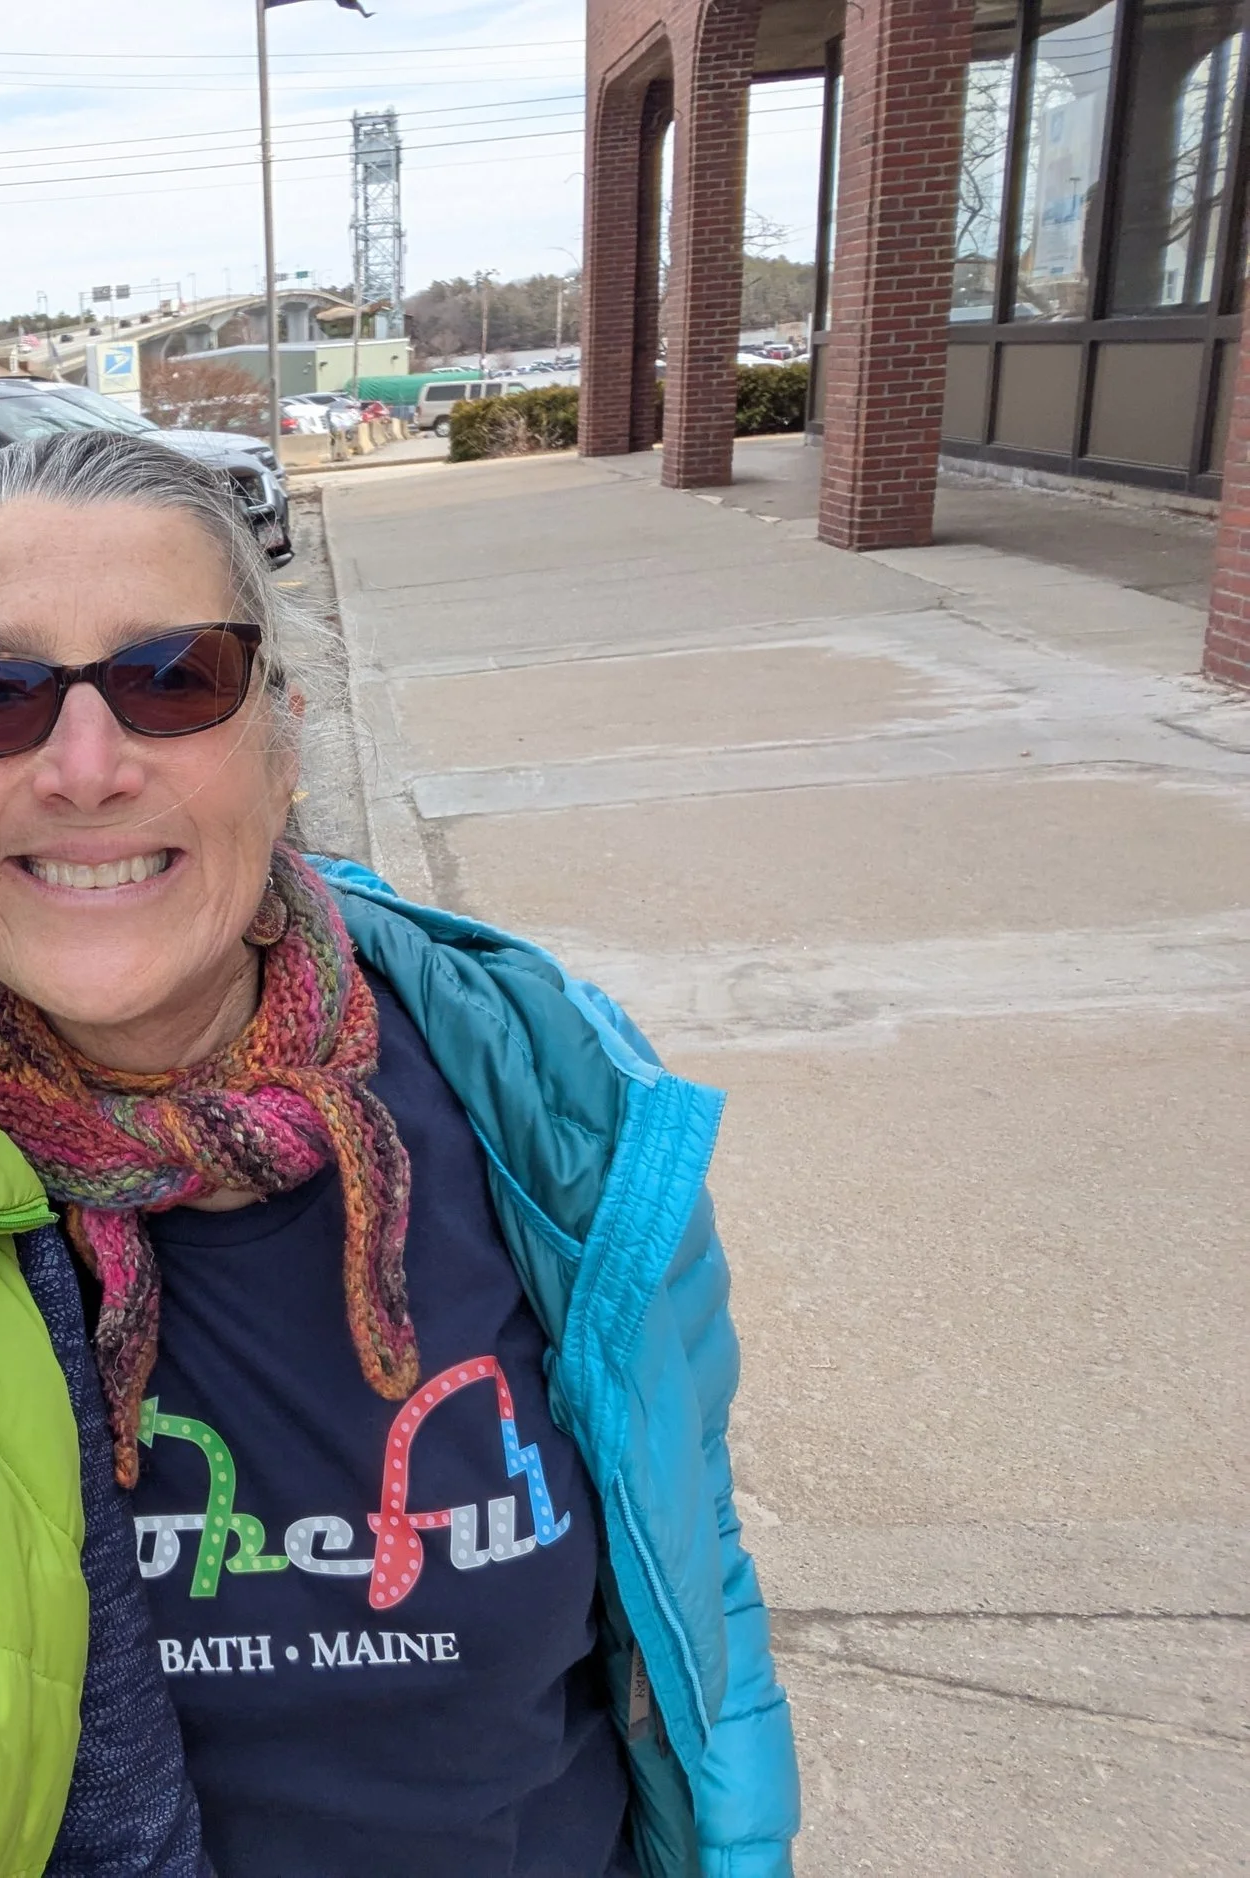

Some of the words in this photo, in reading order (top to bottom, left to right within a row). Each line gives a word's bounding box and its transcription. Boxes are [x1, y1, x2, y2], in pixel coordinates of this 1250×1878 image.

[134, 1355, 570, 1609] opeful
[158, 1635, 274, 1673] BATH
[309, 1631, 460, 1667] MAINE
